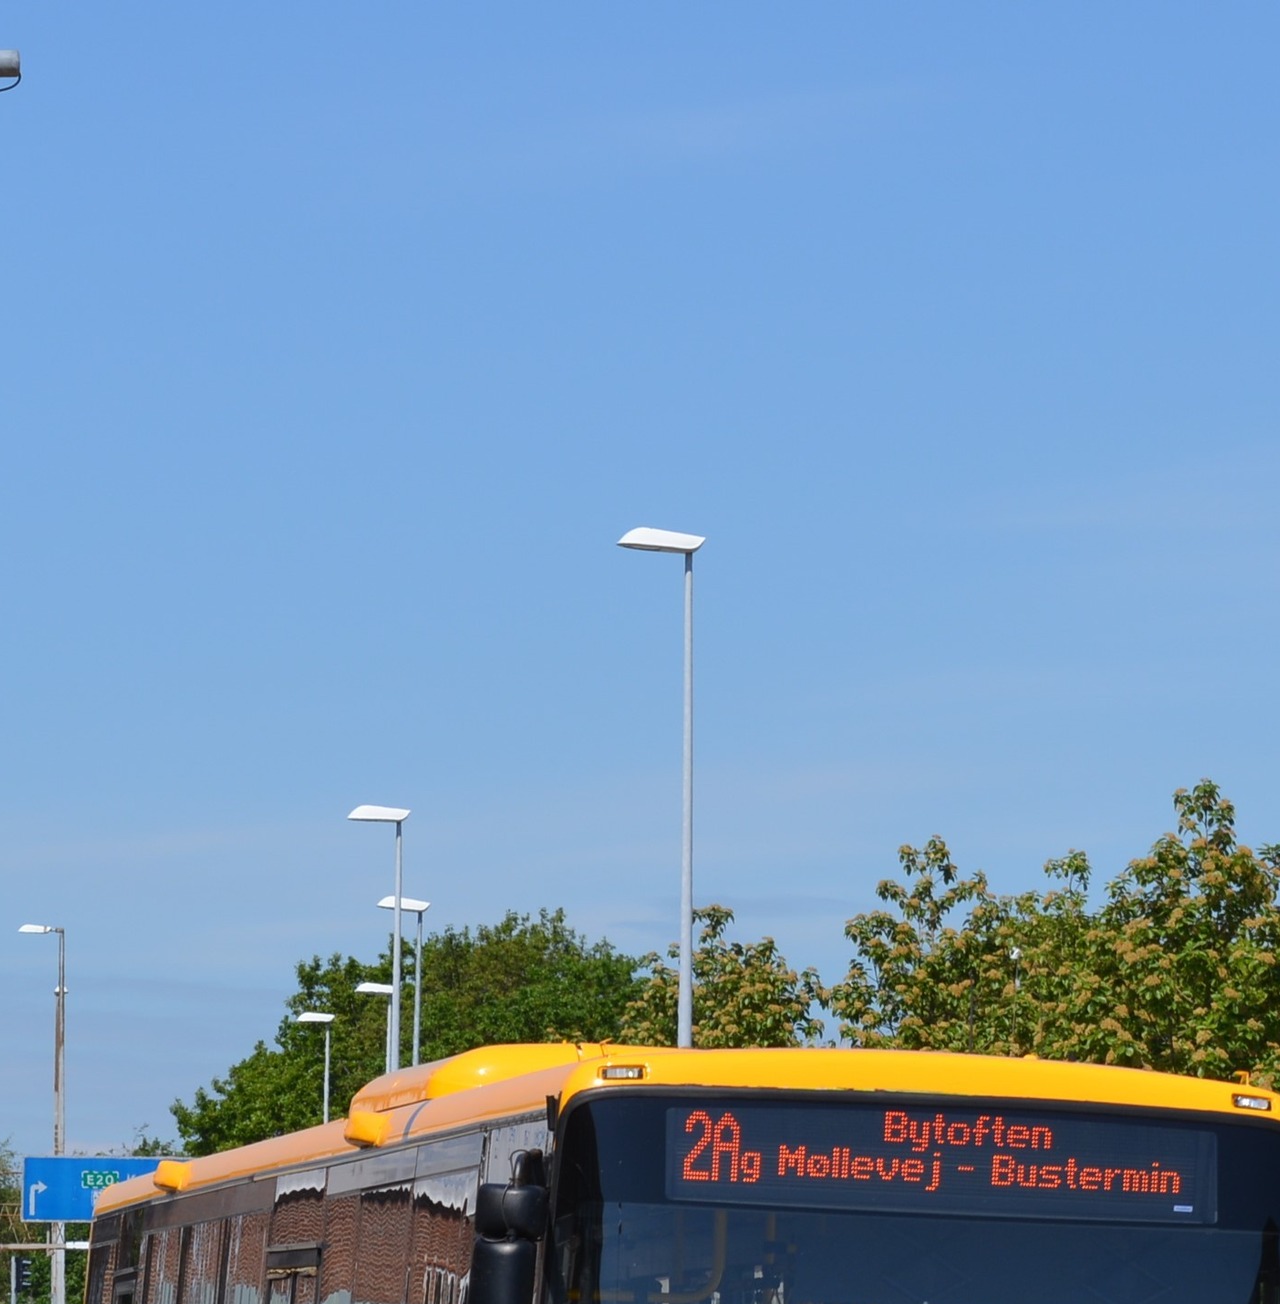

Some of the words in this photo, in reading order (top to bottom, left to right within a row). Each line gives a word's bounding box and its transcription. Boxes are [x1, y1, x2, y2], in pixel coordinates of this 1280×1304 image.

[884, 1111, 1053, 1152] Bytoften
[86, 1174, 115, 1187] E20
[777, 1145, 942, 1191] Møllevej
[991, 1154, 1181, 1194] Bustermin
